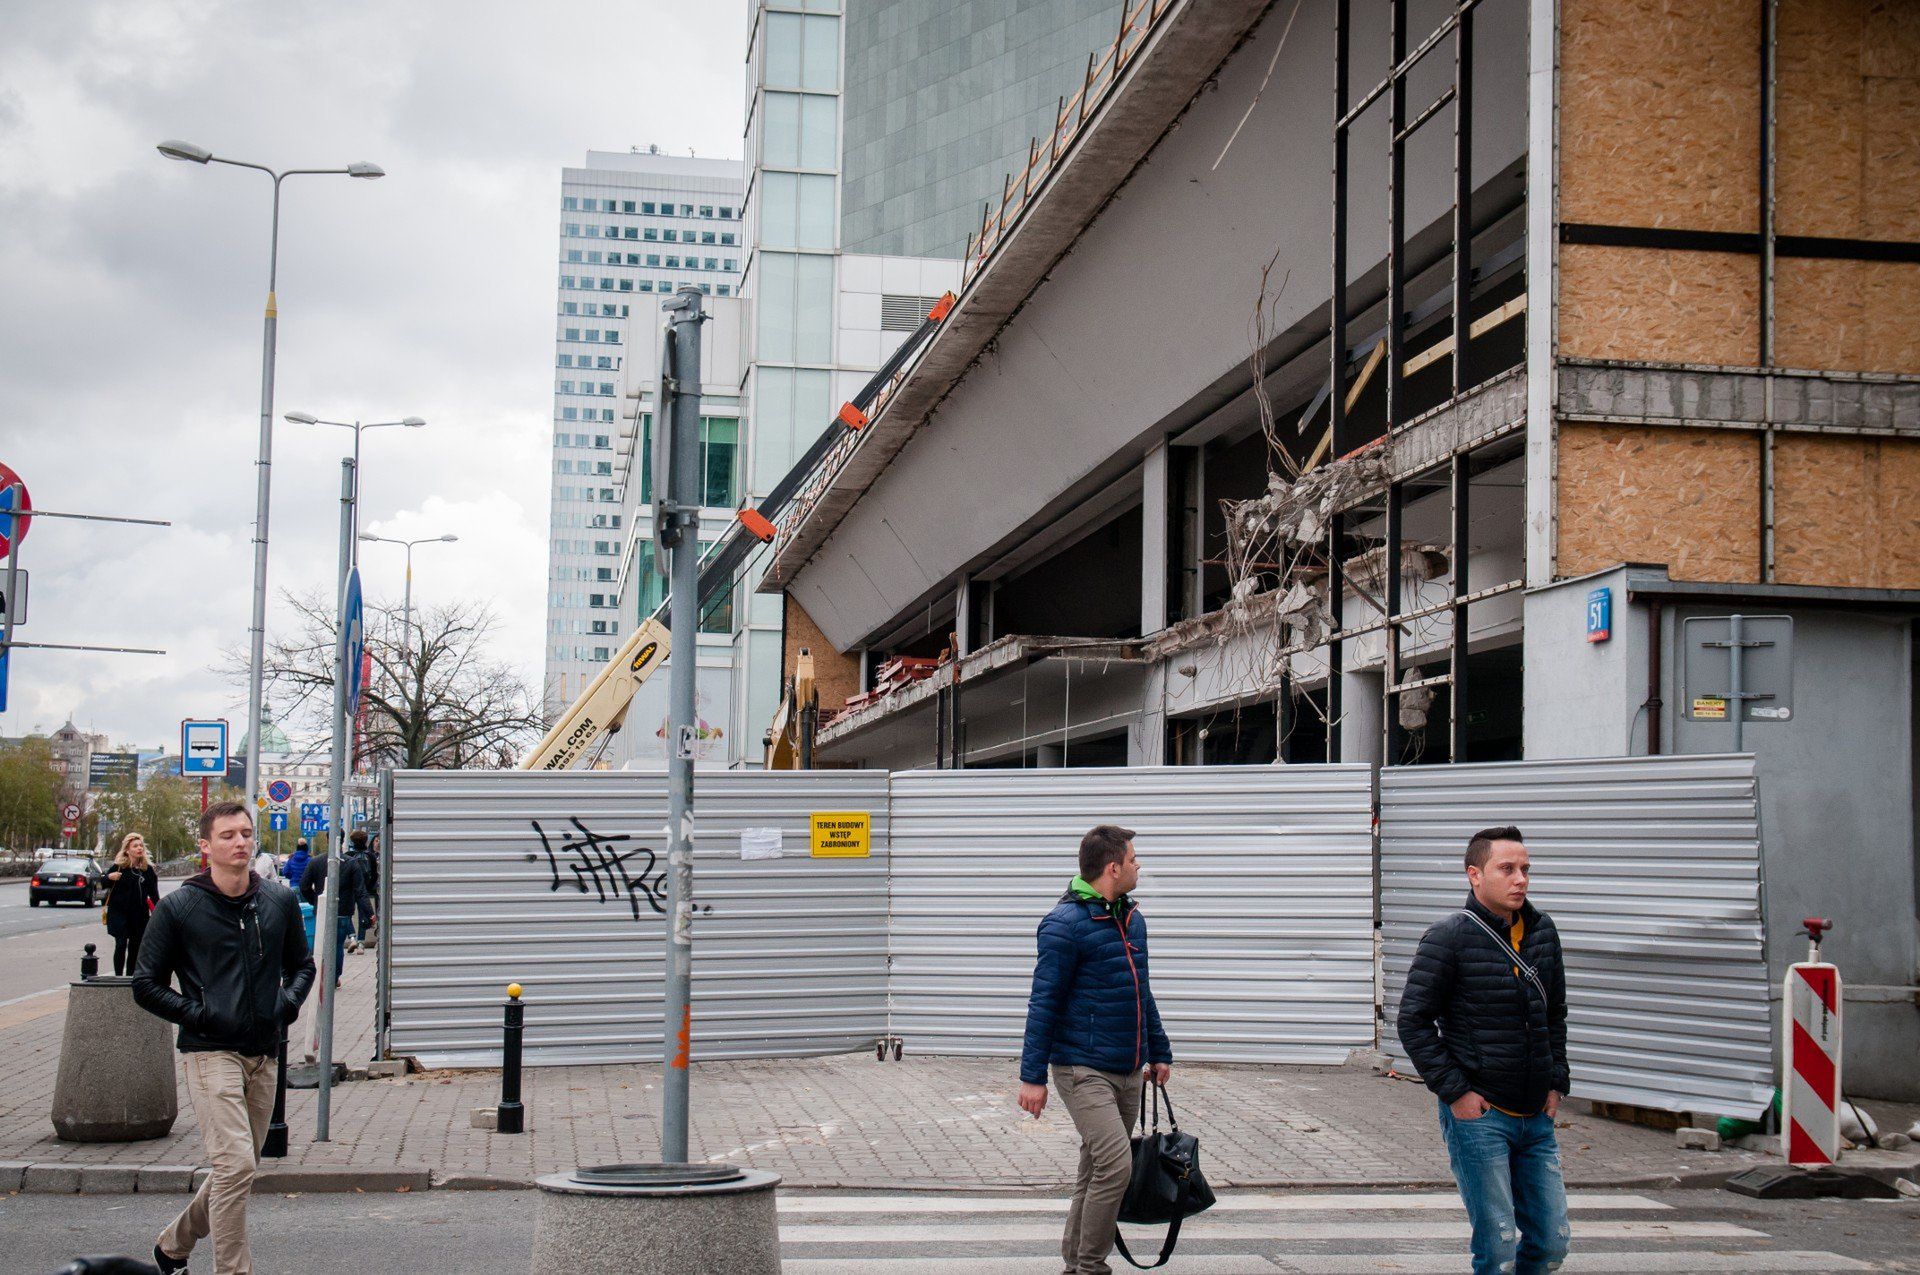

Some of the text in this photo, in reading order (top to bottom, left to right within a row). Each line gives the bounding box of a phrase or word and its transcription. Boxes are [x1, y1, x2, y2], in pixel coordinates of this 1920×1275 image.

[1590, 602, 1602, 630] 51
[633, 646, 655, 669] RIWAL
[830, 831, 851, 839] WSTĘP
